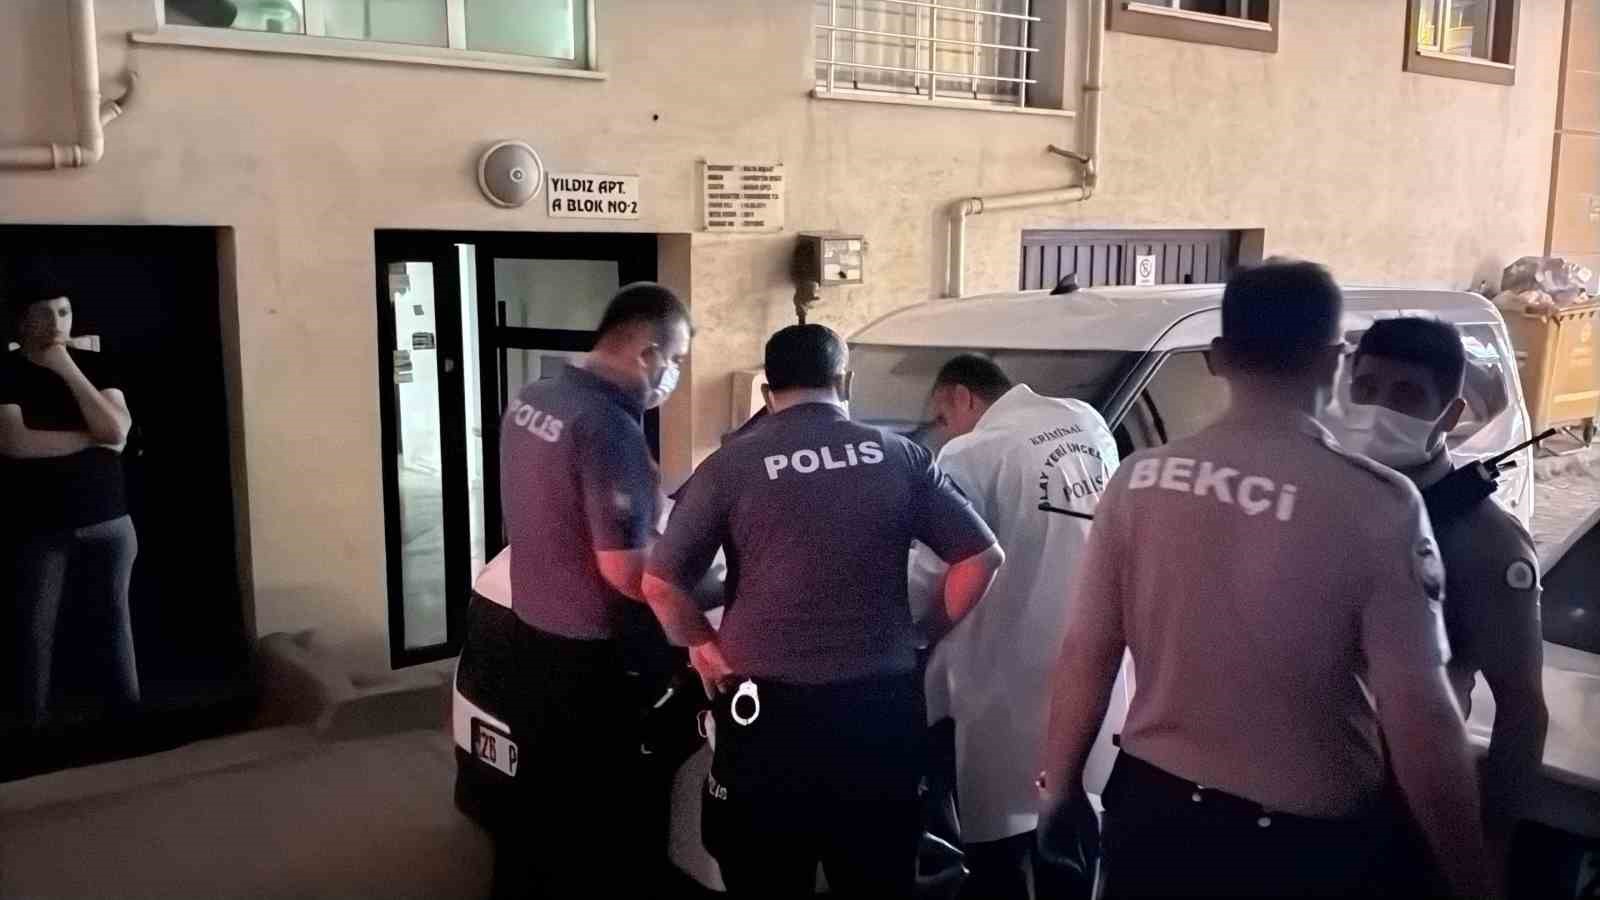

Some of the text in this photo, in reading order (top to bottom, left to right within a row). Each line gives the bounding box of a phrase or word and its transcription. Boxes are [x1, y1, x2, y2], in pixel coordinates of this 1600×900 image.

[552, 177, 626, 194] YILDIZ APT.
[552, 198, 562, 213] A
[567, 199, 604, 213] BLOK
[763, 440, 884, 480] POLİS
[480, 732, 497, 763] 26
